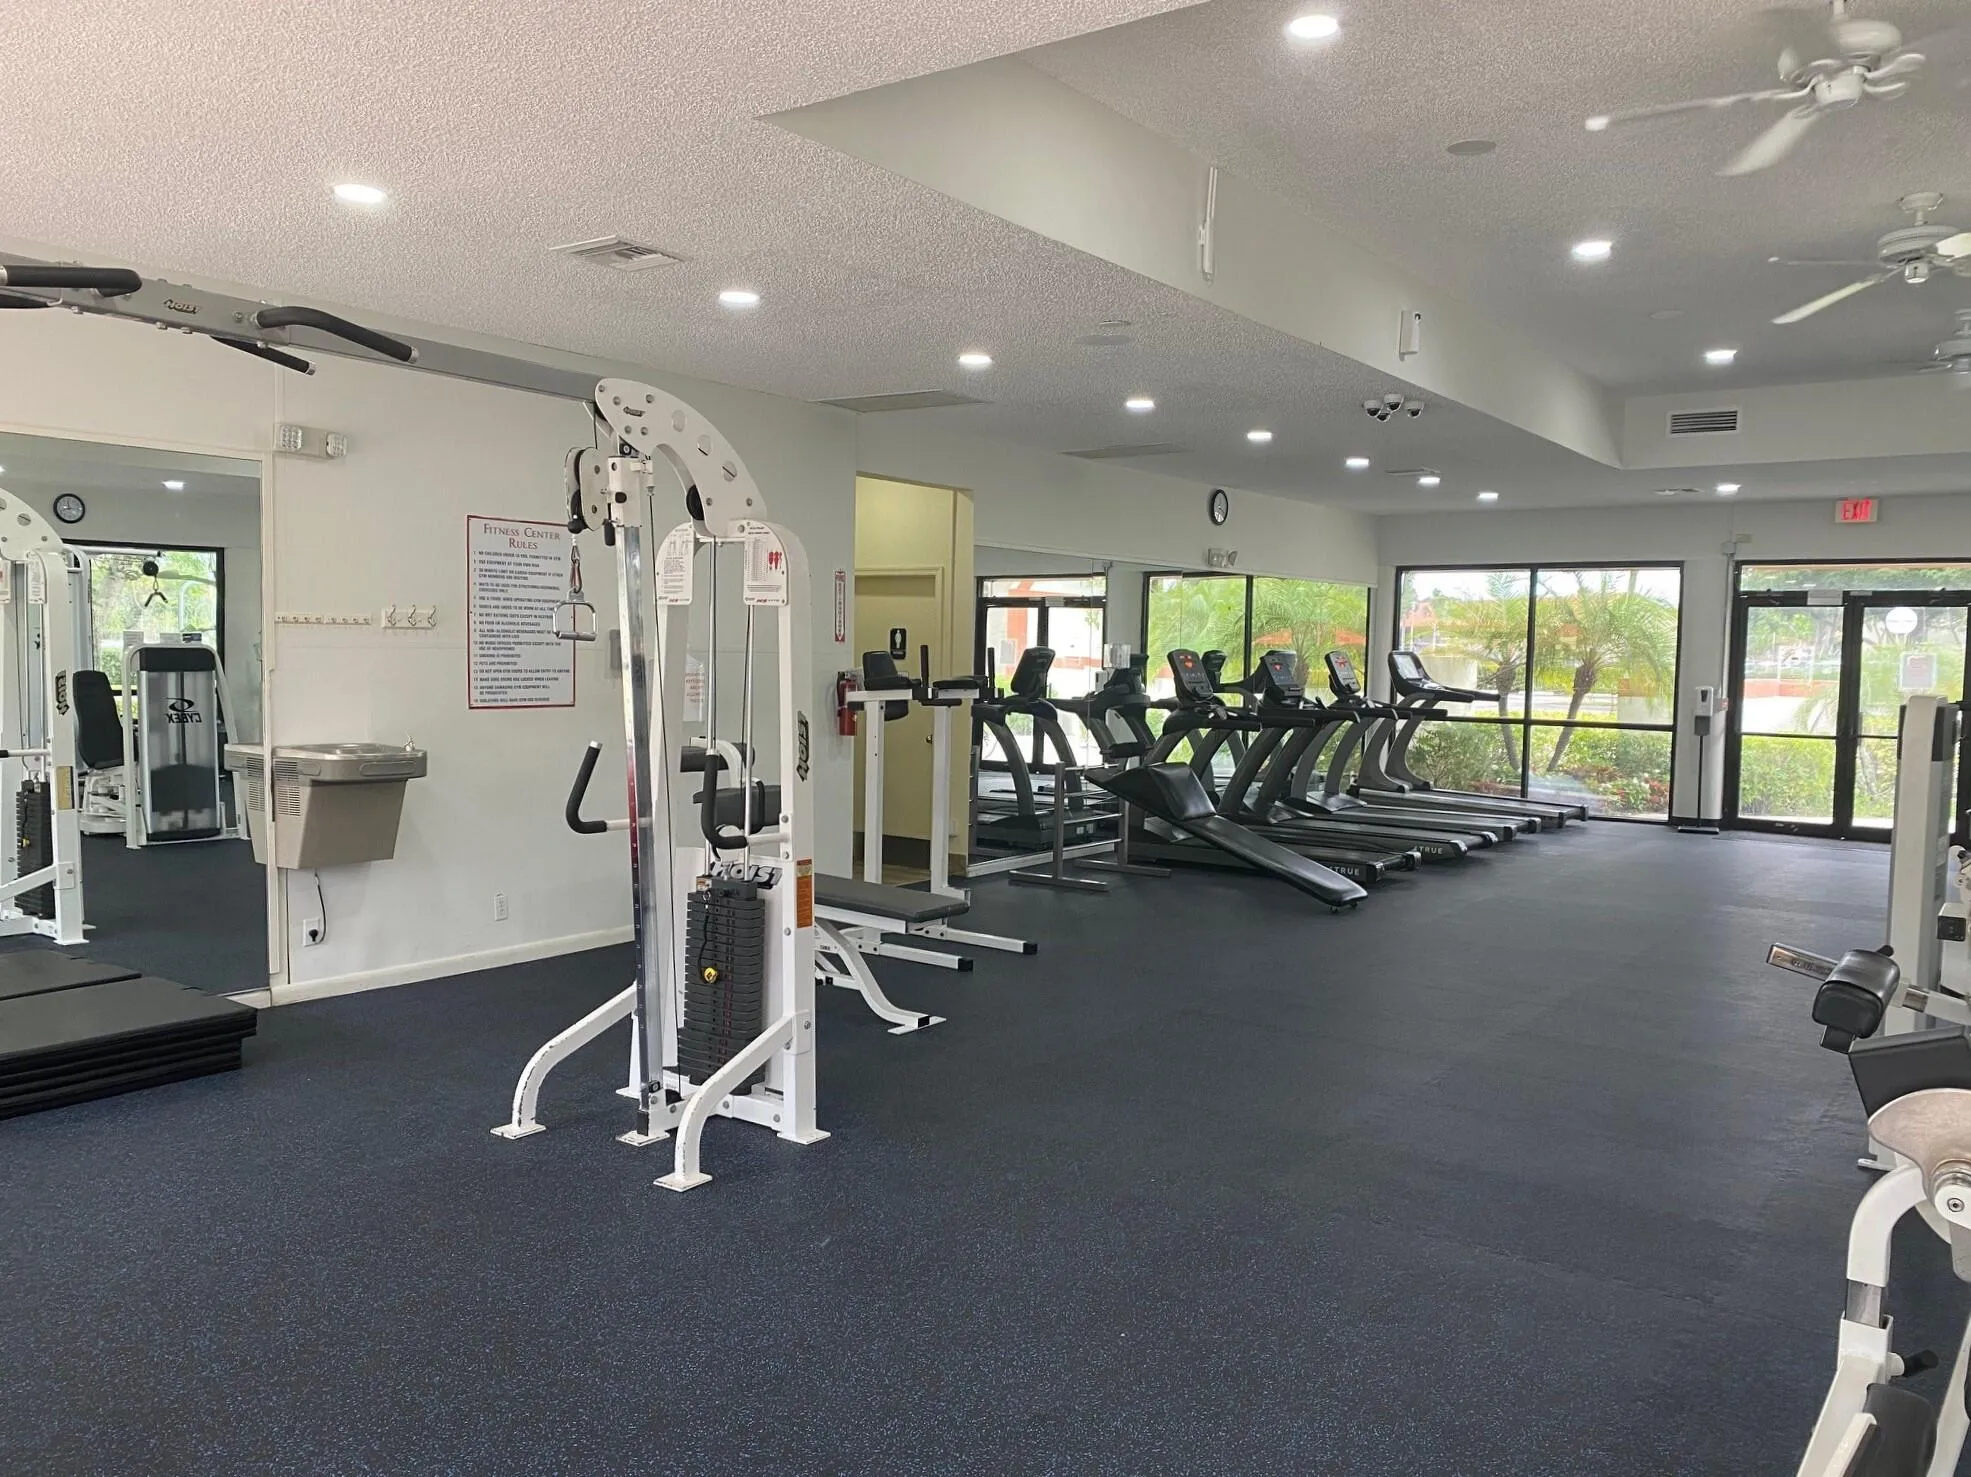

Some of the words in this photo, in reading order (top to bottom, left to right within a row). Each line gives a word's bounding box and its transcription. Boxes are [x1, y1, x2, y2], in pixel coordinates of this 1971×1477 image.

[1842, 498, 1871, 520] EXIT
[483, 523, 519, 537] FITNESS
[523, 527, 561, 540] CENTER
[509, 538, 538, 550] RULES
[796, 710, 810, 782] HOIST
[1419, 846, 1443, 855] TRUE
[711, 858, 783, 889] HOIST
[1333, 866, 1360, 876] TRUE
